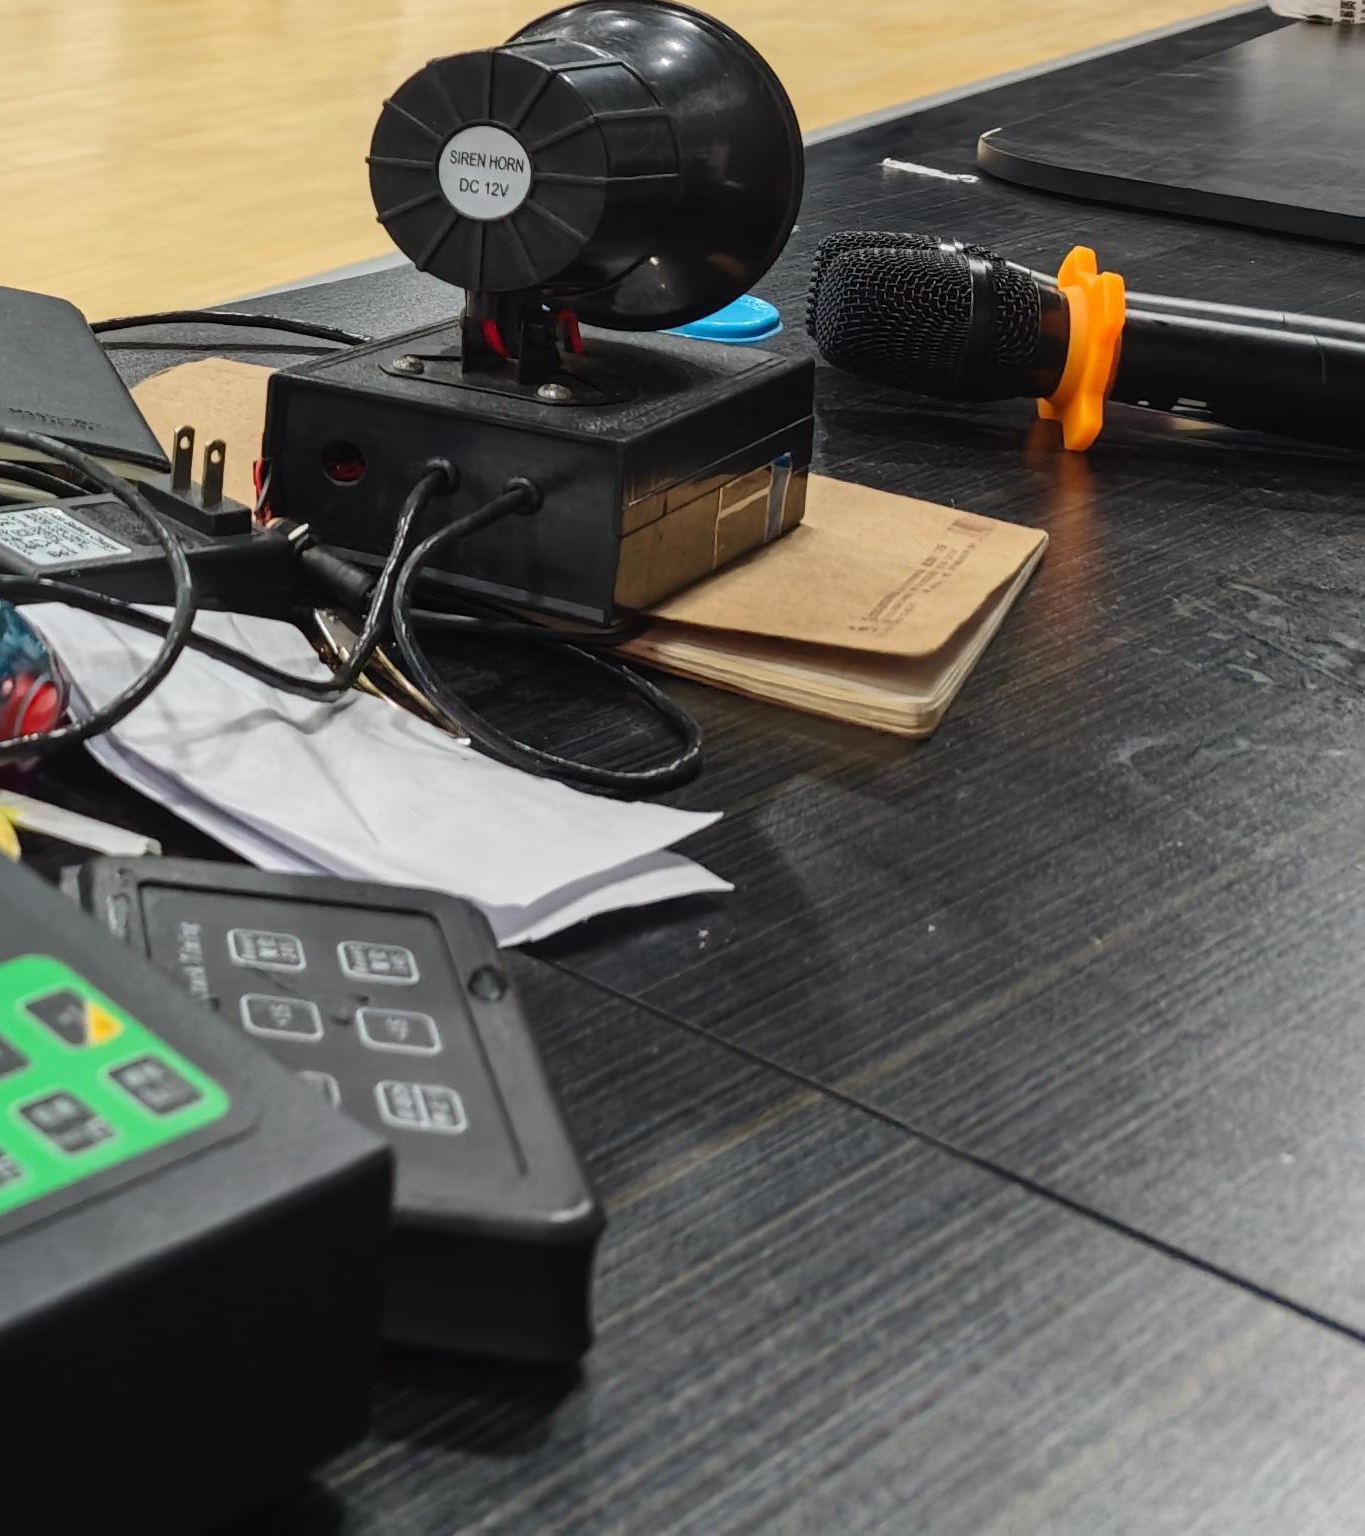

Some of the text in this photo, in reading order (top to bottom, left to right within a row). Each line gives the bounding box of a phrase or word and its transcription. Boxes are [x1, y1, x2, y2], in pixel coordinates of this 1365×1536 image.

[450, 150, 525, 174] SIREN HORN
[459, 177, 510, 199] DC 12V
